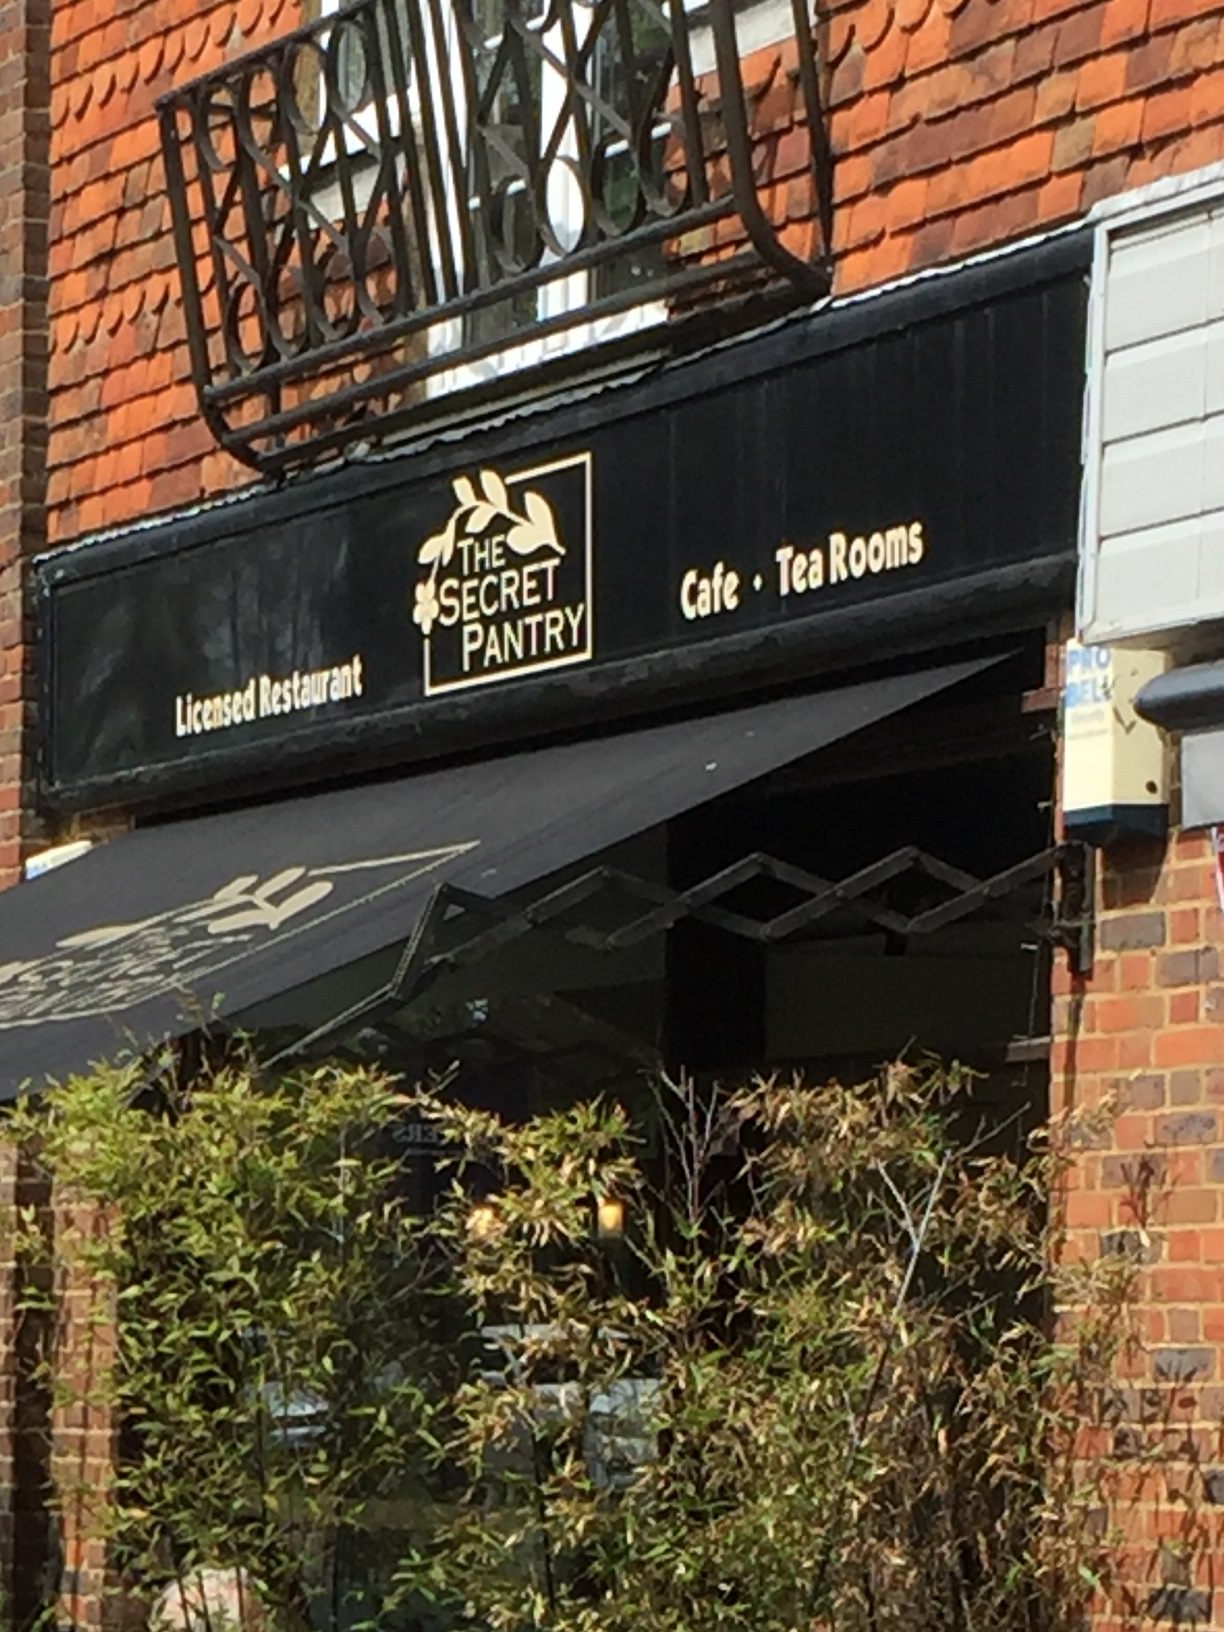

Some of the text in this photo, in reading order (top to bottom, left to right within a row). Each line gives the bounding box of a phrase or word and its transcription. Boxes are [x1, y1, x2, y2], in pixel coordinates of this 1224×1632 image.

[457, 534, 506, 576] THE
[680, 521, 923, 620] Cafe Tea Rooms
[439, 557, 561, 626] SECRET
[462, 603, 584, 672] PANTRY
[176, 653, 363, 737] Licensed Restaurant
